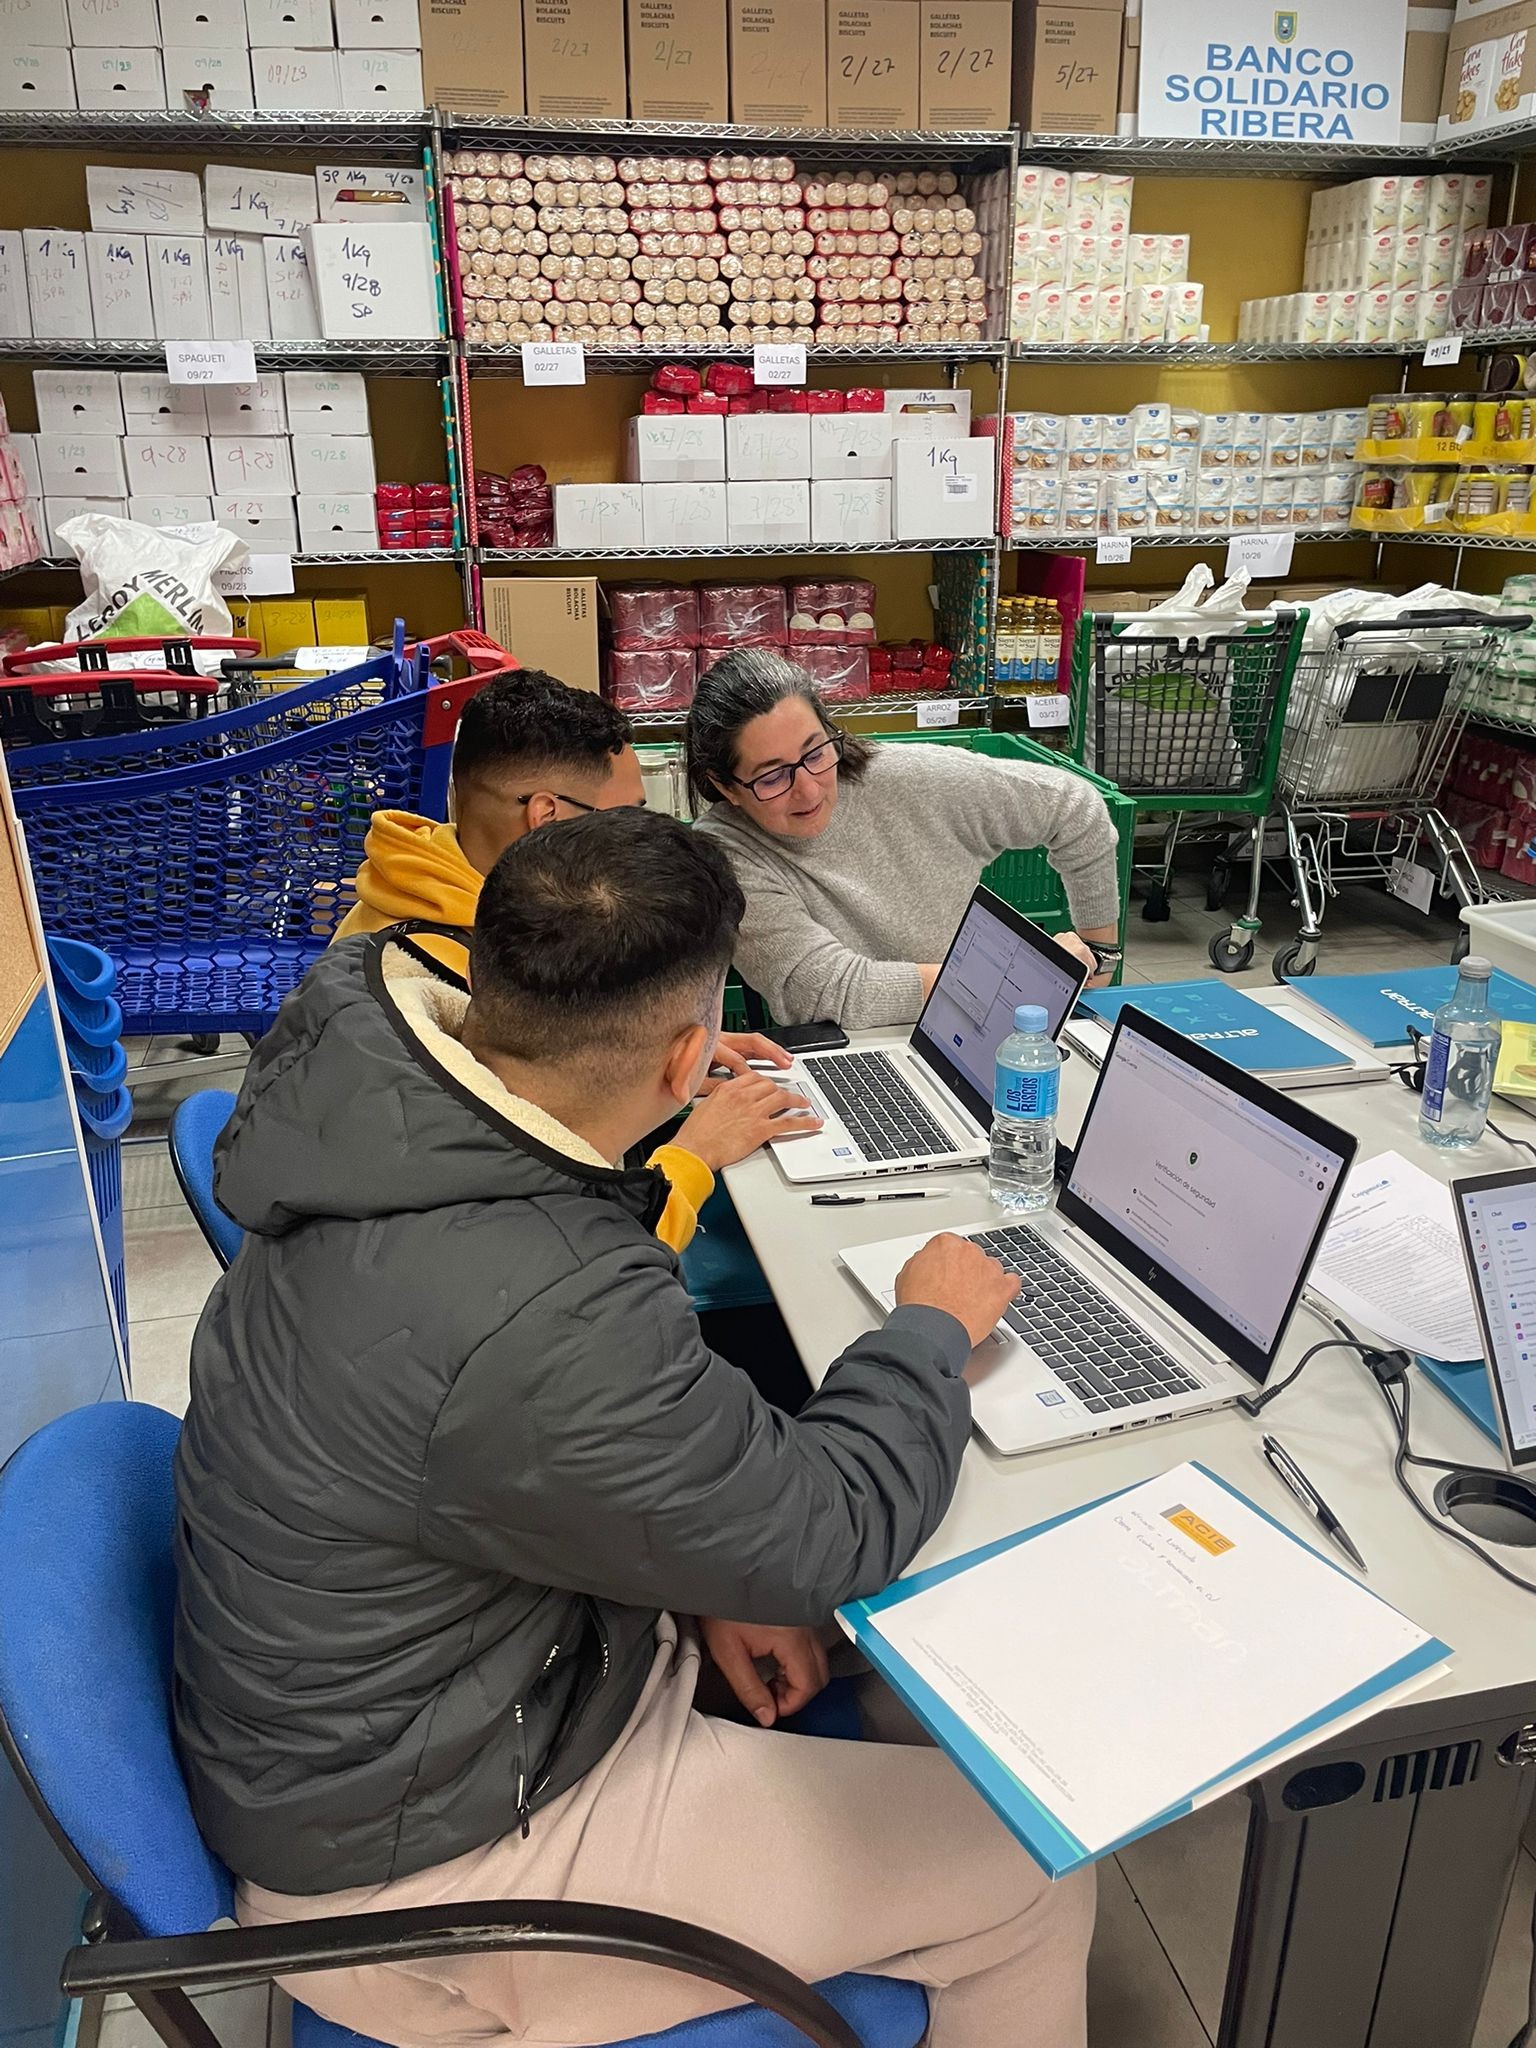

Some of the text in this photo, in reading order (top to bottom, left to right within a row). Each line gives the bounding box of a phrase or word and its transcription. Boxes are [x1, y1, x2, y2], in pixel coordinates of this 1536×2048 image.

[431, 7, 461, 15] BISCUITS
[536, 7, 571, 15] BOLACHAS
[838, 11, 869, 19] GALLETAS
[536, 16, 566, 24] BISCUITS
[640, 12, 675, 20] BOLACHAS
[930, 13, 960, 21] GALLETAS
[640, 21, 670, 29] BISCUITS
[838, 20, 871, 28] BOLACHAS
[930, 22, 962, 30] BOLACHAS
[1045, 19, 1074, 27] GALLETAS
[838, 28, 866, 36] BISCUITS
[930, 30, 957, 38] BISCUITS
[1045, 28, 1076, 36] BOLACHAS
[1044, 36, 1070, 45] BISCUITS
[551, 38, 589, 57] 2/27
[654, 39, 692, 71] 2/27
[938, 47, 994, 79] 2/27
[1206, 43, 1354, 78] BANCO
[841, 55, 895, 85] 2/27
[1056, 60, 1099, 90] 5/27
[1165, 74, 1390, 111] SOLIDARIO
[1200, 107, 1354, 141] RIBERA
[341, 237, 372, 268] 1Kg
[341, 272, 382, 297] 9/28
[533, 346, 577, 356] GALLETAS
[178, 353, 225, 363] SPAGUETI
[759, 355, 800, 365] GALLETAS
[534, 363, 559, 371] 02/27
[187, 370, 213, 379] 09/27
[768, 370, 791, 379] 02/27
[927, 447, 958, 475] 1 Kg
[1240, 538, 1268, 546] HARINA
[1104, 554, 1124, 562] 10/26
[1241, 552, 1261, 560] 10/26
[76, 575, 140, 642] LEROY
[926, 703, 951, 712] ARROZ
[1039, 711, 1059, 719] 03/27
[926, 716, 946, 724] 05/26
[1021, 1077, 1039, 1113] RISCOS
[1006, 1088, 1022, 1112] LOS
[1190, 1184, 1216, 1208] seguridad
